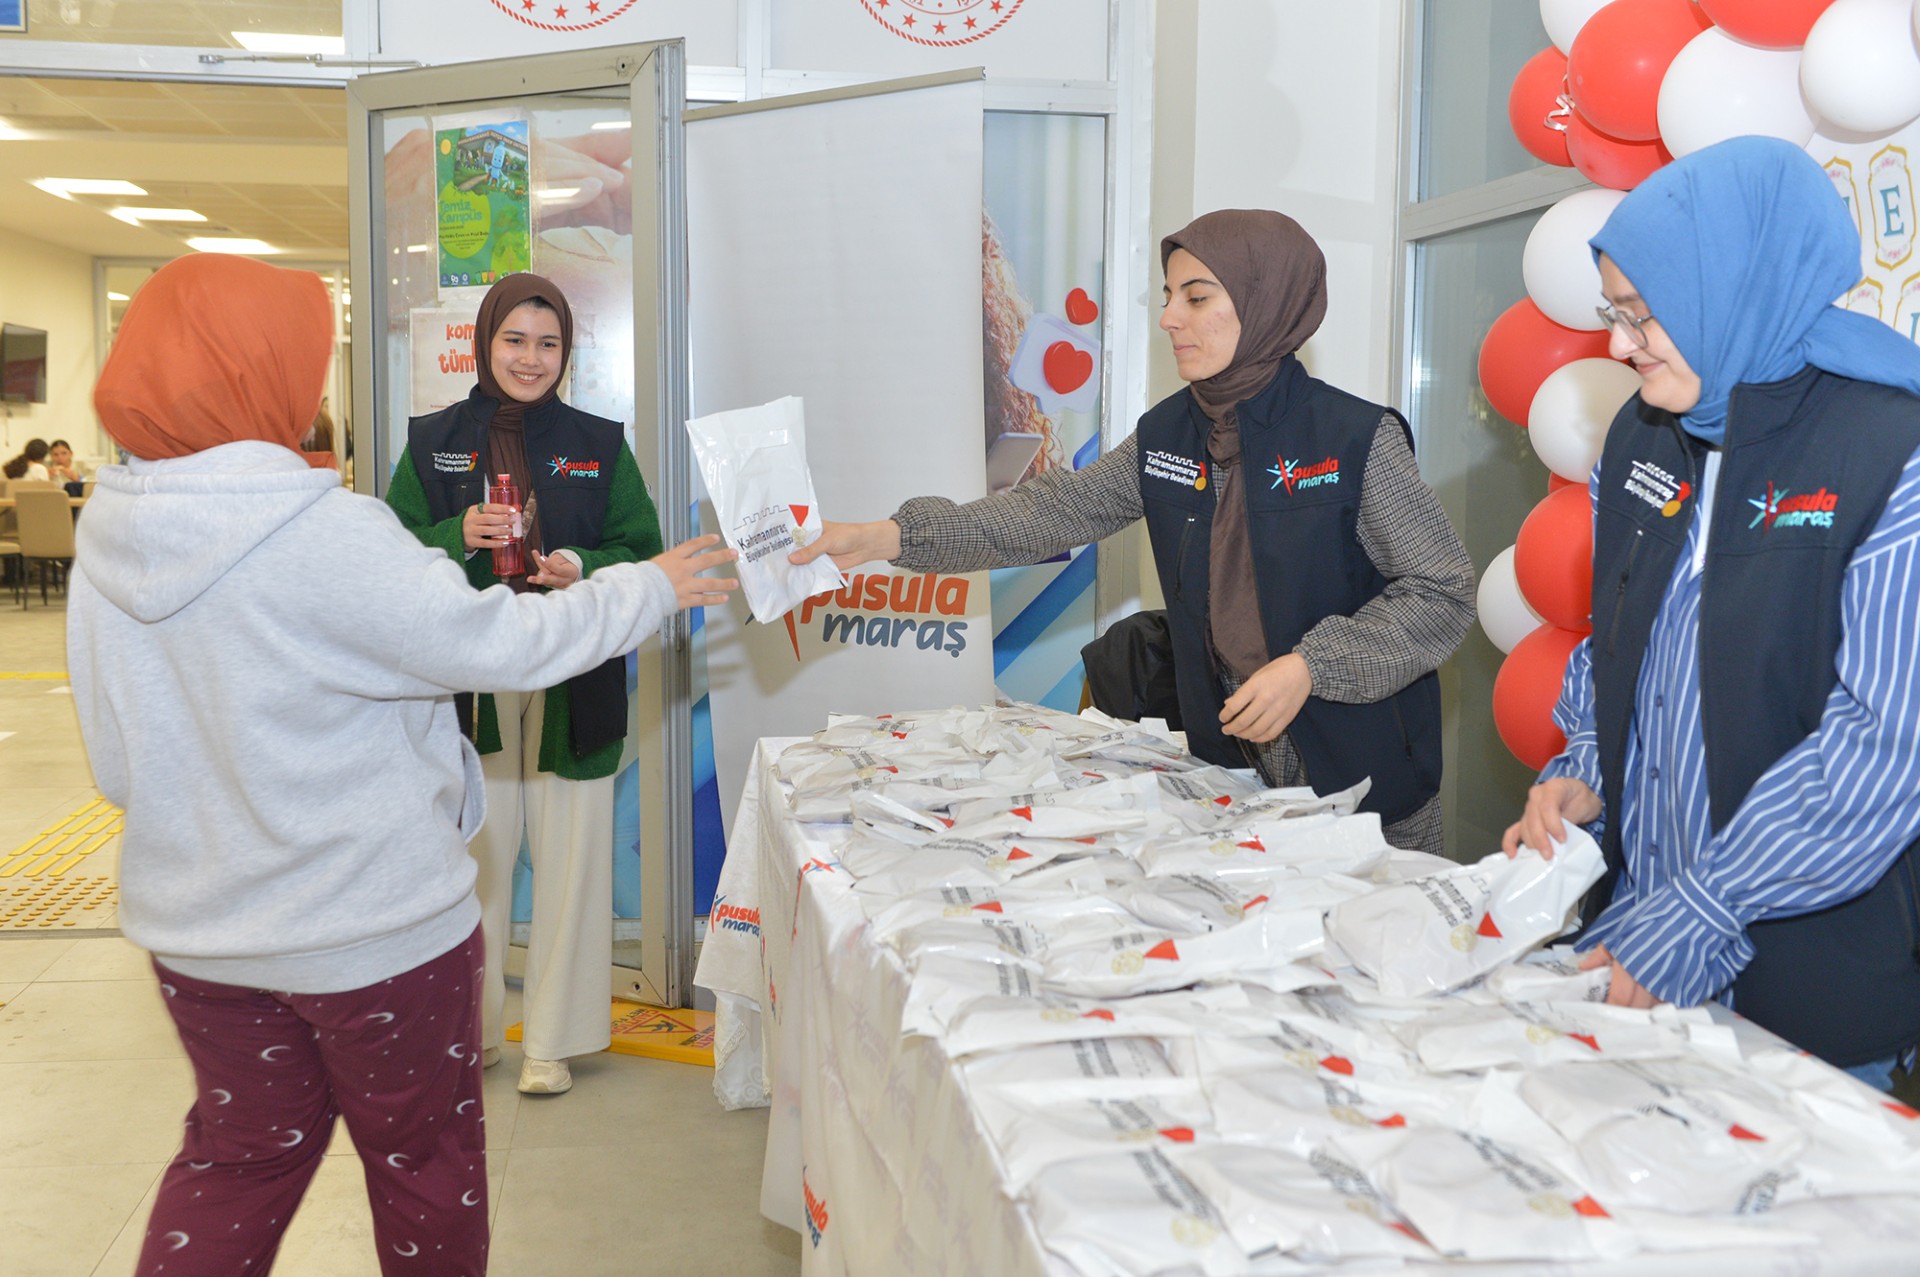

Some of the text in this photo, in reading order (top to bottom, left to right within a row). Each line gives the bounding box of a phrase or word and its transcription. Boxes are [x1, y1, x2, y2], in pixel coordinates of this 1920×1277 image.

[1879, 185, 1904, 237] E
[565, 460, 600, 473] pusula
[1291, 456, 1340, 485] pusula
[1298, 471, 1340, 490] maraş
[822, 613, 968, 658] maraş
